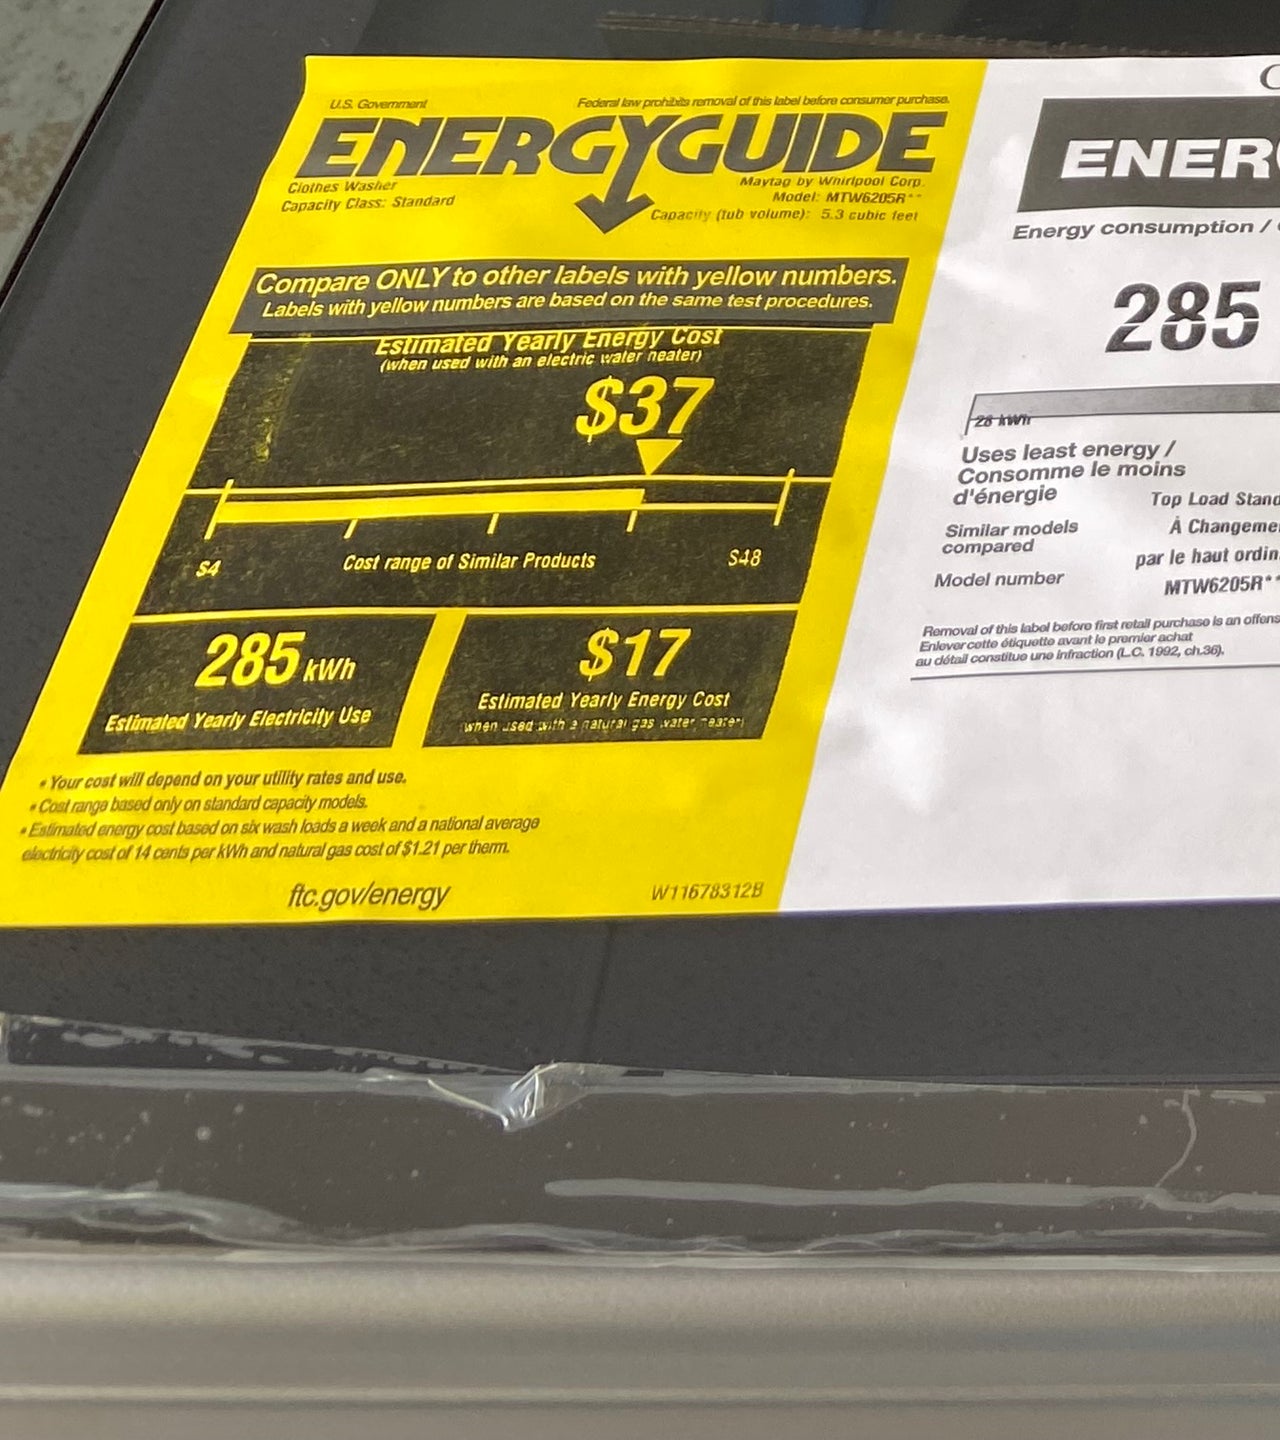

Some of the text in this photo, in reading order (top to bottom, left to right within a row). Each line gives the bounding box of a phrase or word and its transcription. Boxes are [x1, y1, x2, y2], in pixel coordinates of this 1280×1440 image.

[330, 99, 428, 109] U.S. Government
[295, 111, 948, 185] ENERGYGUIDE
[288, 181, 397, 194] Clothes Washer
[740, 177, 791, 188] Maytag
[797, 177, 814, 187] by
[890, 176, 921, 188] Corp.
[772, 192, 816, 202] Model:
[1013, 224, 1095, 240] Energy
[1101, 220, 1254, 237] consumption
[256, 264, 896, 298] Compare ONLY to other labels with yellow numbers.
[1104, 280, 1262, 353] 285
[576, 375, 715, 443] $37
[1152, 492, 1182, 509] Top
[1188, 492, 1229, 506] Load
[343, 552, 596, 573] Cost range of Similar Products
[194, 632, 356, 687] 285 kWh
[579, 627, 691, 682] $17
[288, 881, 452, 912] ftc.gov/energy
